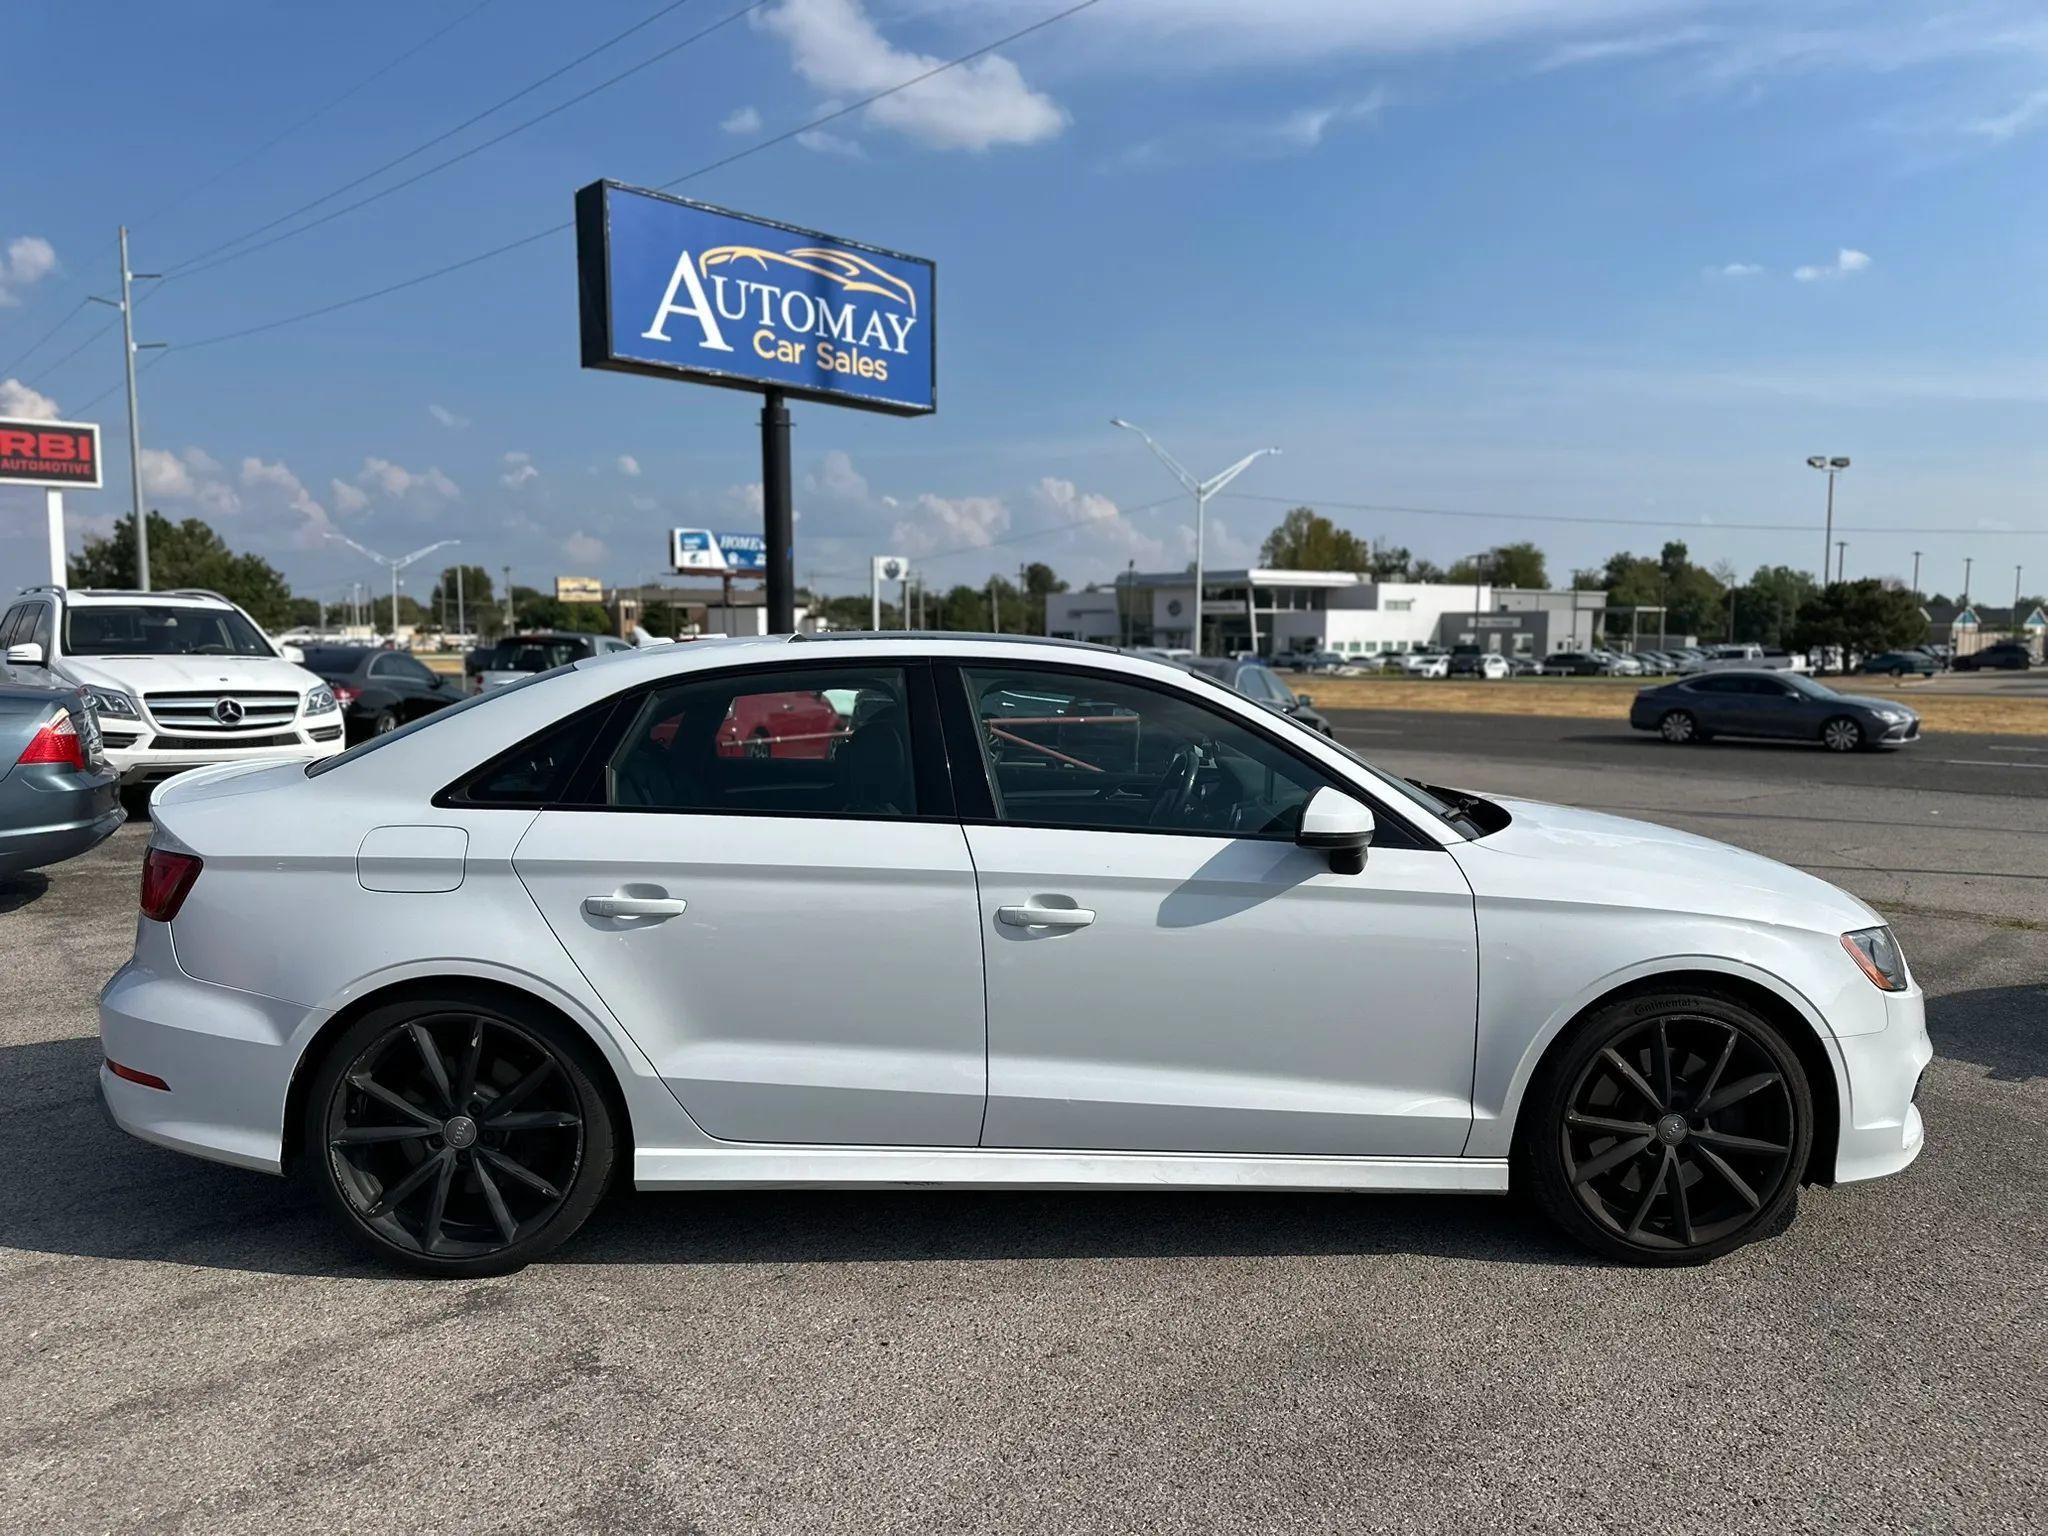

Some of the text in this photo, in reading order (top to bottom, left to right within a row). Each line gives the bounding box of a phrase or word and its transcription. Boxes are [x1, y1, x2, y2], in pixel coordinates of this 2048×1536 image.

[641, 250, 916, 354] AUTOMAY
[753, 329, 888, 380] Car Sales
[0, 430, 90, 461] RBI
[1, 459, 91, 474] AUTOMOTIVE
[1634, 998, 1691, 1016] Continental
